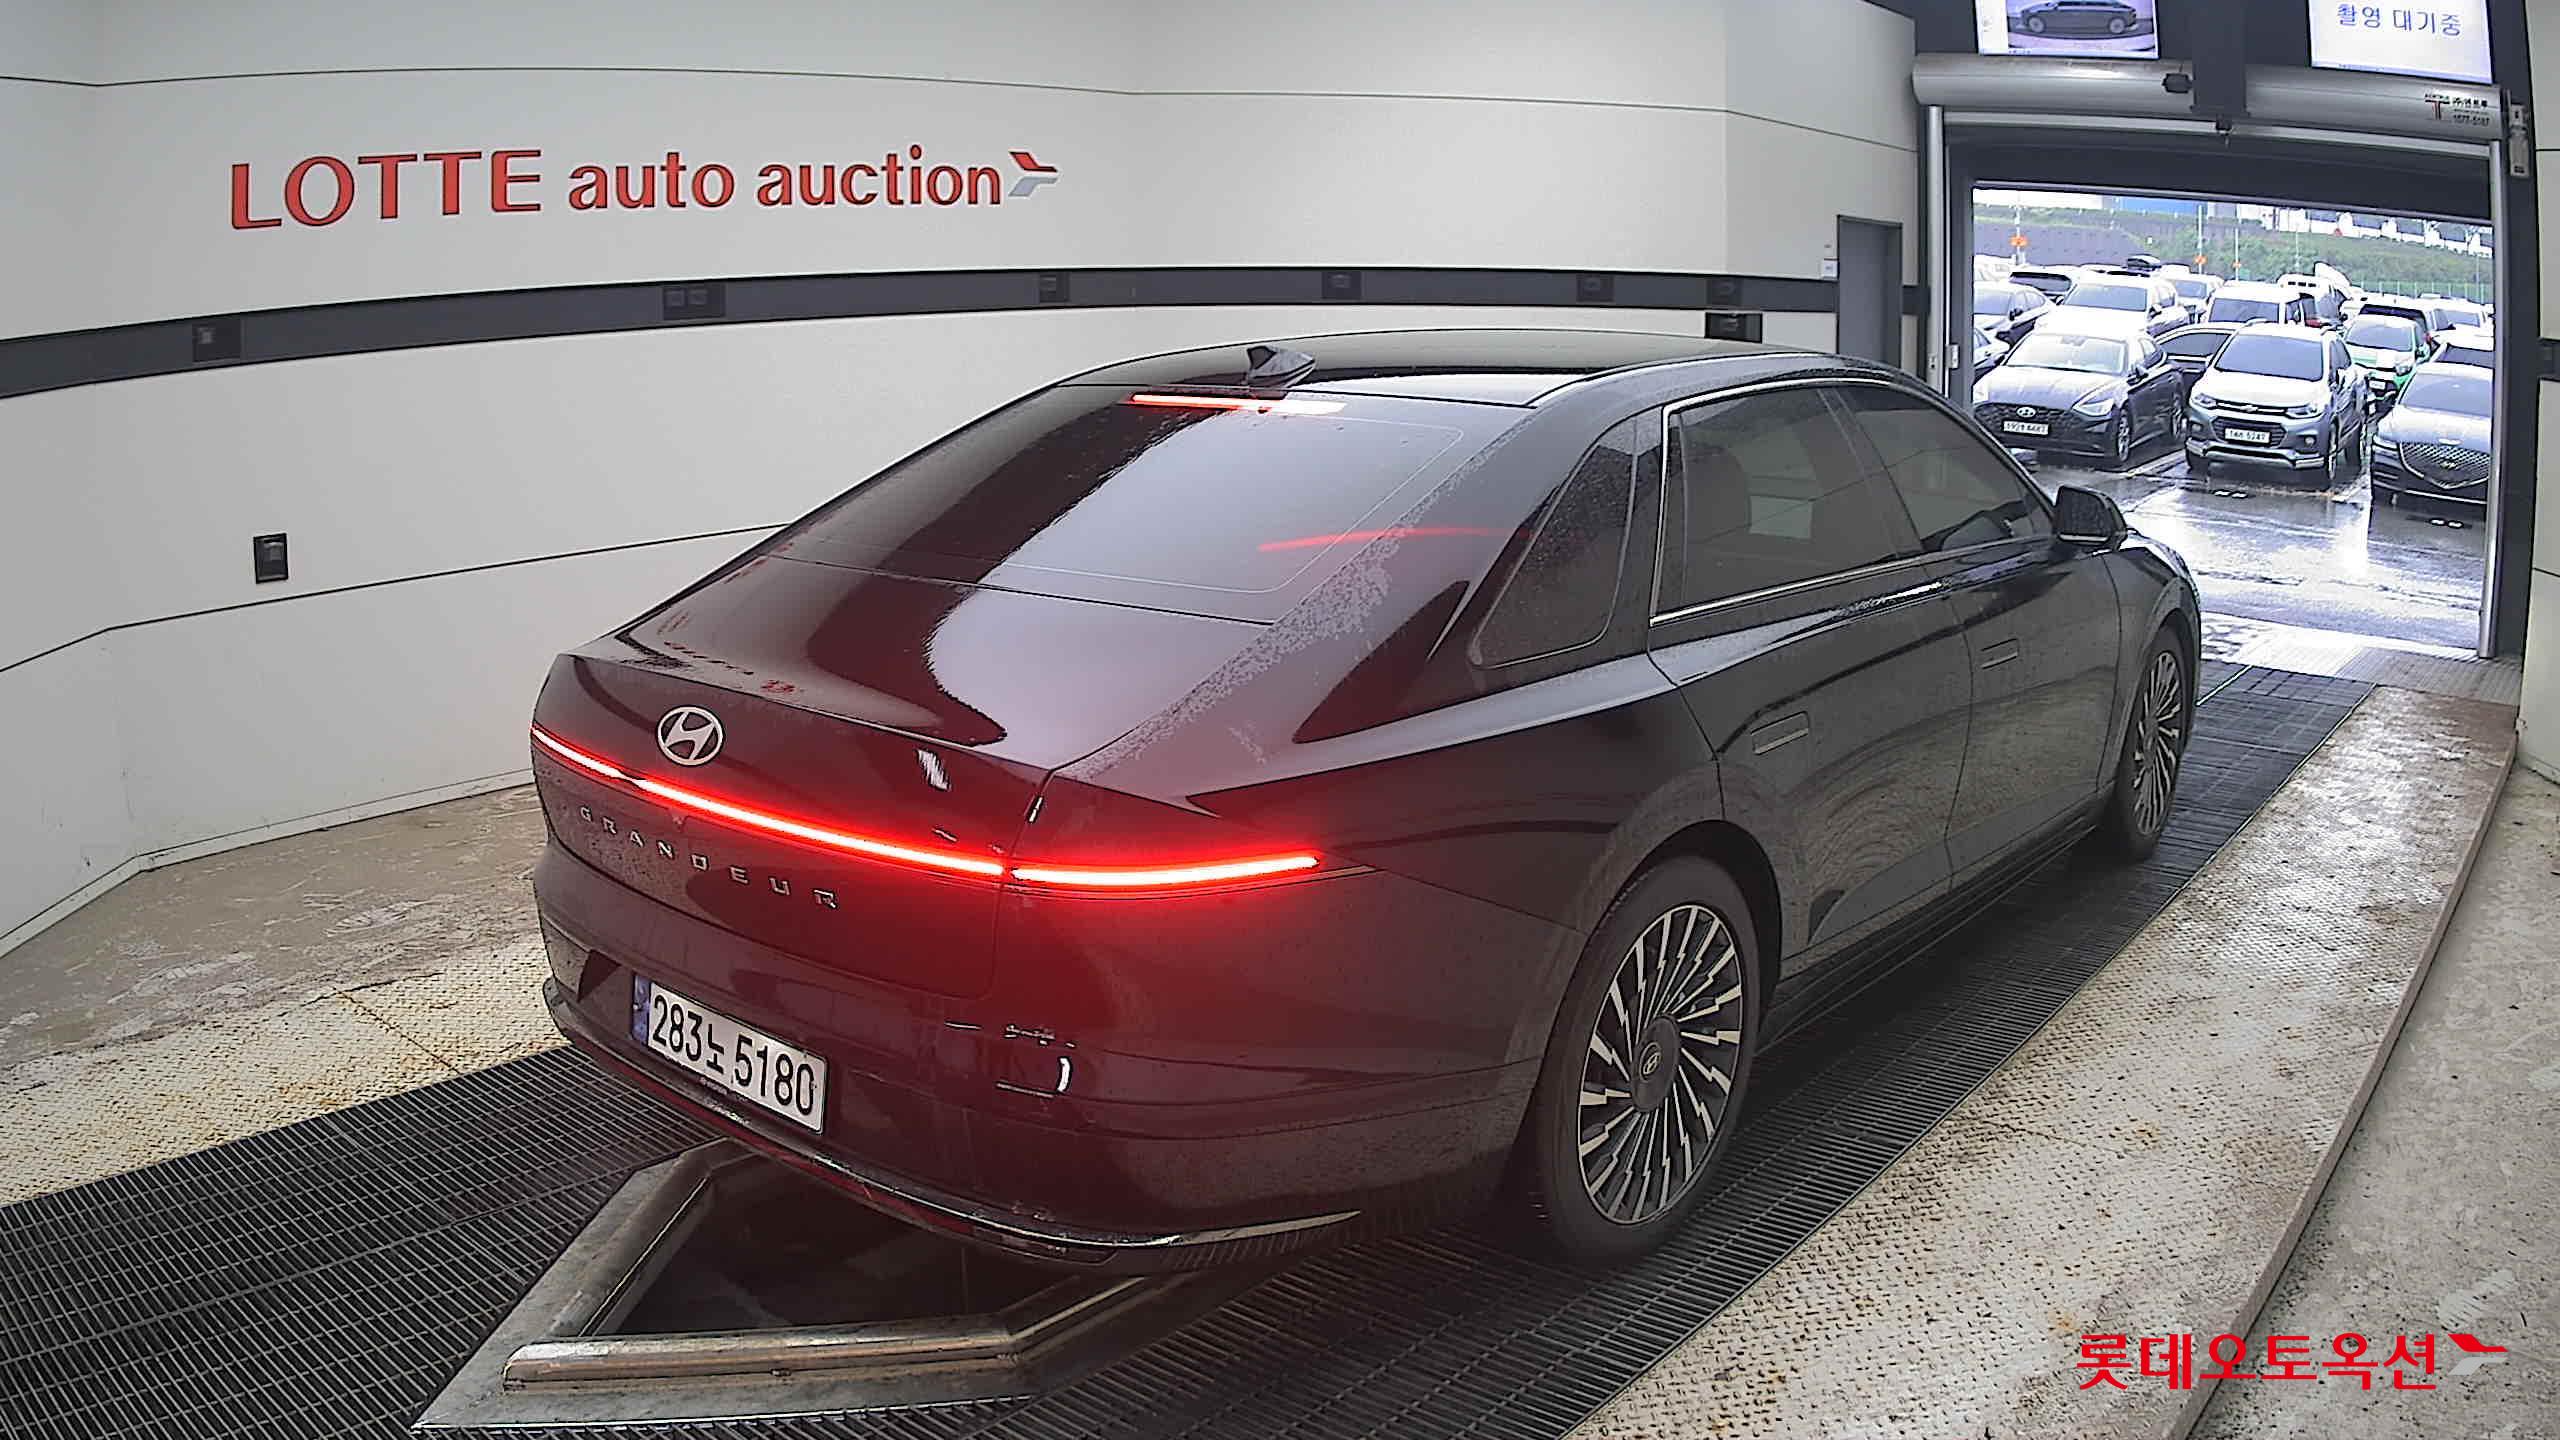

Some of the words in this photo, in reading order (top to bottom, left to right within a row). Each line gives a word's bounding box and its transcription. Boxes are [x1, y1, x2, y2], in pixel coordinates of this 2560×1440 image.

[2337, 4, 2381, 29] 촬영
[2392, 9, 2462, 37] 대기중
[231, 150, 543, 231] LOTTE
[568, 152, 736, 210] auto
[756, 145, 1002, 207] auction
[579, 805, 839, 909] GRANDEUR
[652, 993, 726, 1075] 283노
[733, 1035, 815, 1117] 5180
